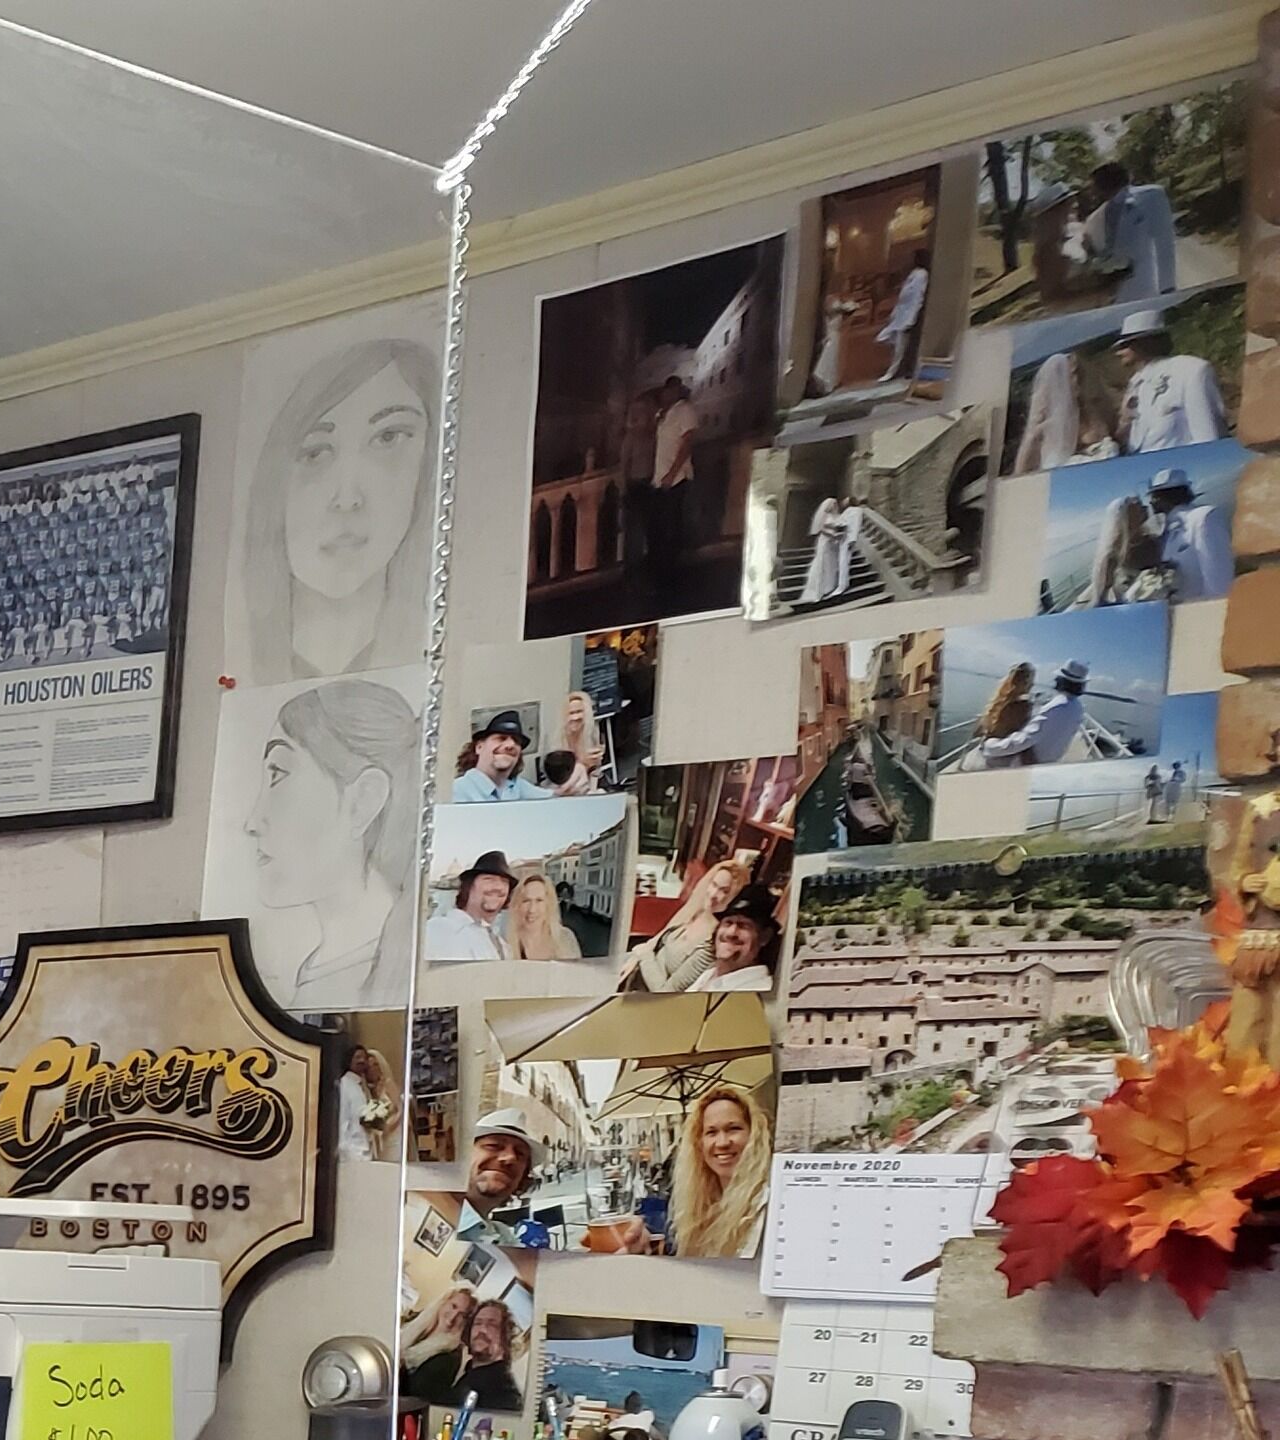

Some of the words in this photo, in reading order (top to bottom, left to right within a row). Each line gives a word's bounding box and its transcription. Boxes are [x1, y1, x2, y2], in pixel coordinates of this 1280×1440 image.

[2, 675, 86, 706] HOUSTON
[90, 666, 153, 696] OILERS
[783, 1160, 857, 1171] Novembre
[861, 1160, 901, 1171] 2020
[175, 1183, 251, 1212] 1895
[29, 1218, 208, 1244] BOSTON
[813, 1329, 832, 1341] 20
[859, 1331, 879, 1344] 21
[907, 1334, 928, 1347] 22
[47, 1364, 126, 1408] Soda
[807, 1371, 827, 1384] 27
[854, 1375, 874, 1388] 28
[903, 1378, 924, 1391] 29
